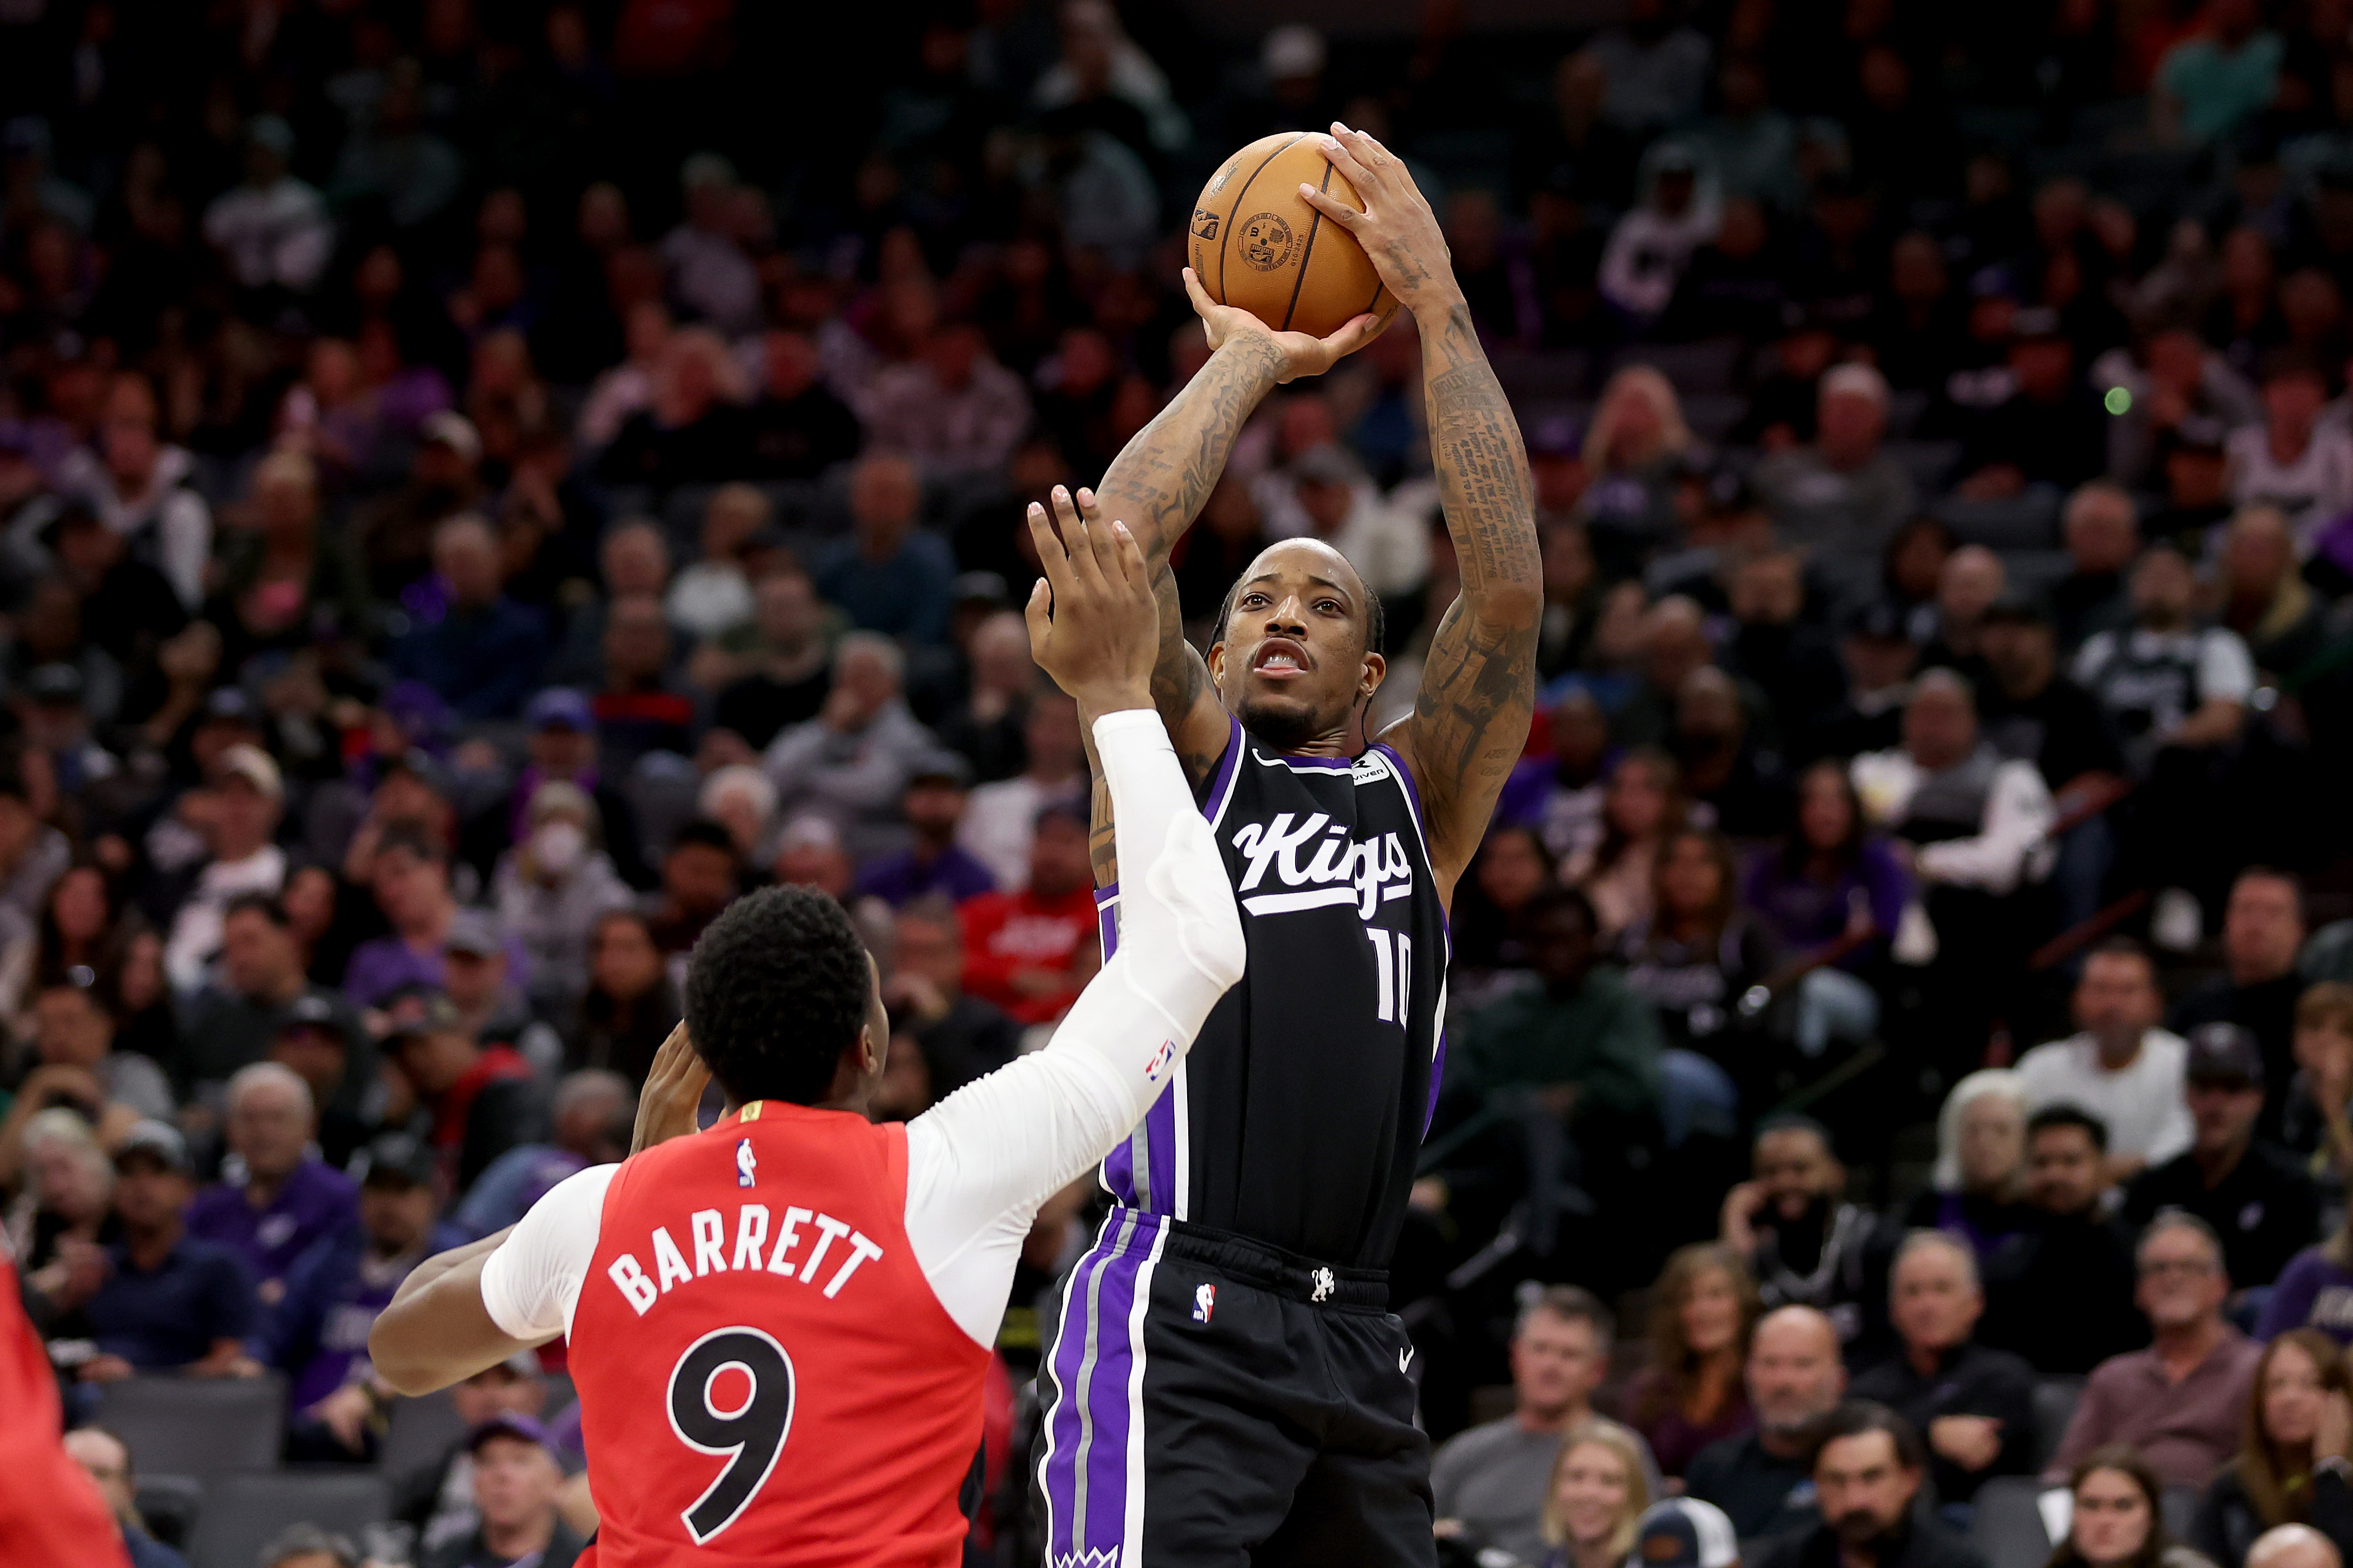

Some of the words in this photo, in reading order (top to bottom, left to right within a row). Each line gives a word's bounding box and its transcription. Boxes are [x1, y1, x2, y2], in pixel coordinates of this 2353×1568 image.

[1232, 812, 1412, 921] Kings
[1366, 927, 1412, 1032] 10
[607, 1204, 884, 1317] BARRETT
[1193, 1310, 1204, 1321] NBA
[666, 1325, 796, 1546] 9
